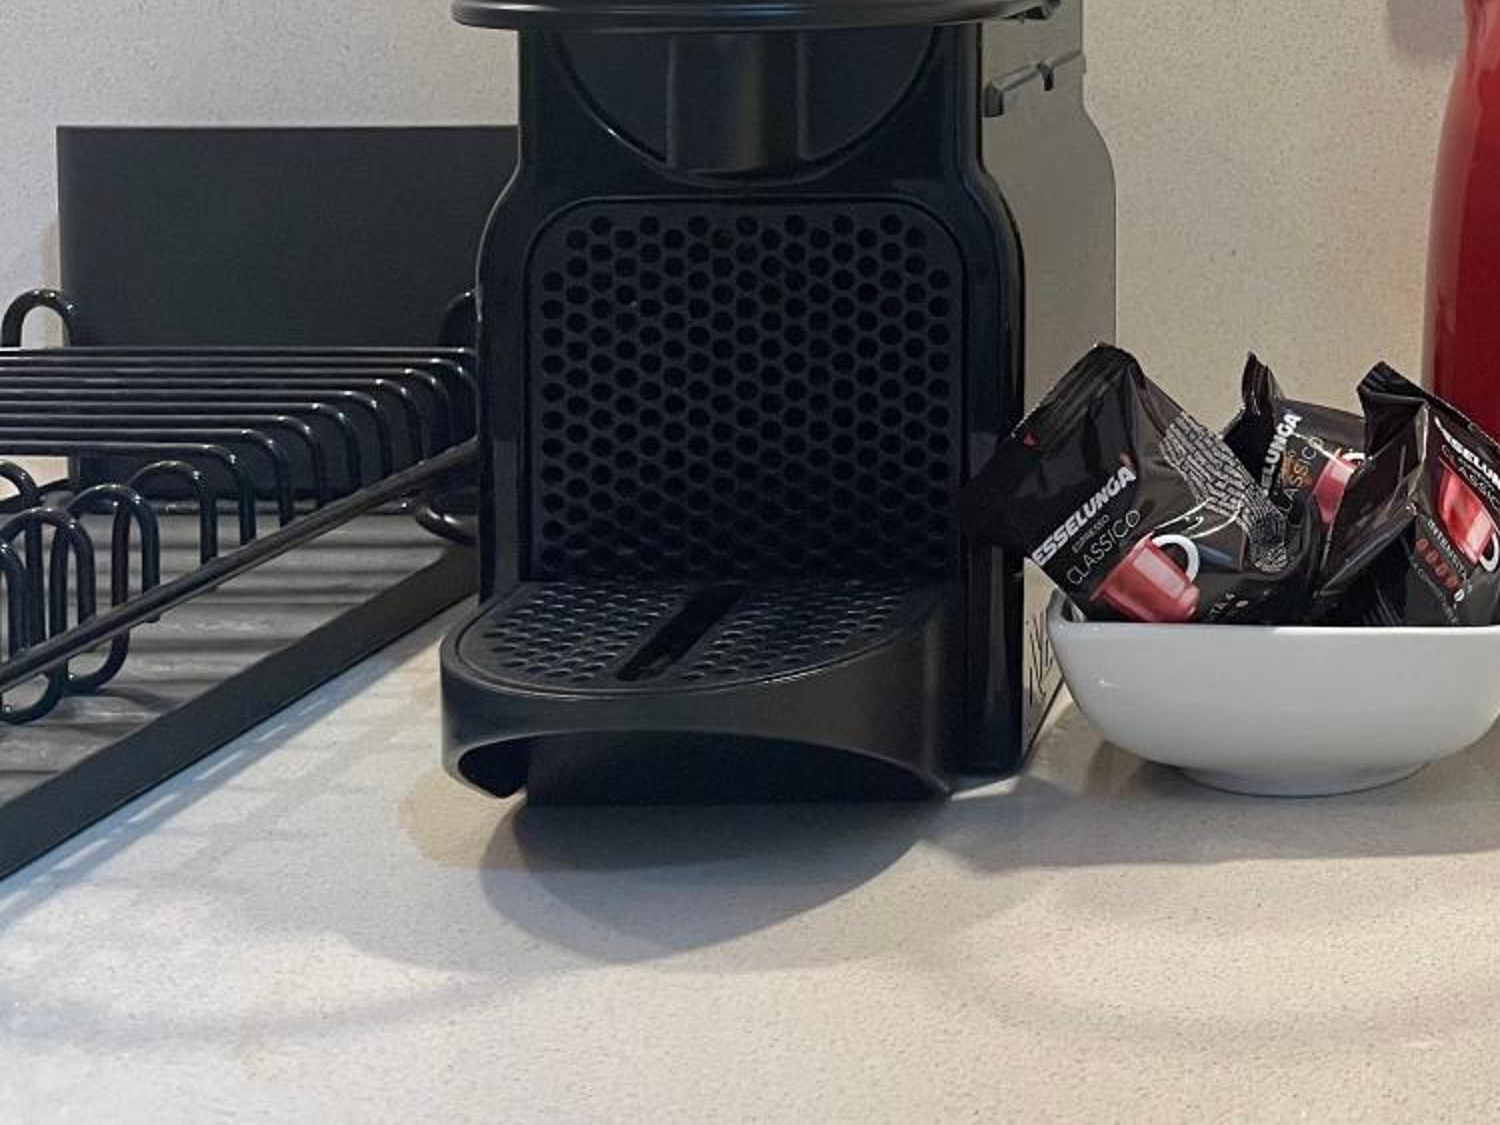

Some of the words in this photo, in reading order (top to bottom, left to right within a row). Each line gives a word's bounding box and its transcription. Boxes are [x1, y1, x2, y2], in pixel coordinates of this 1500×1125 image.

[1279, 436, 1324, 513] LASSICO
[1031, 466, 1137, 567] ESSELUNGA
[1066, 509, 1141, 585] CLASSICO
